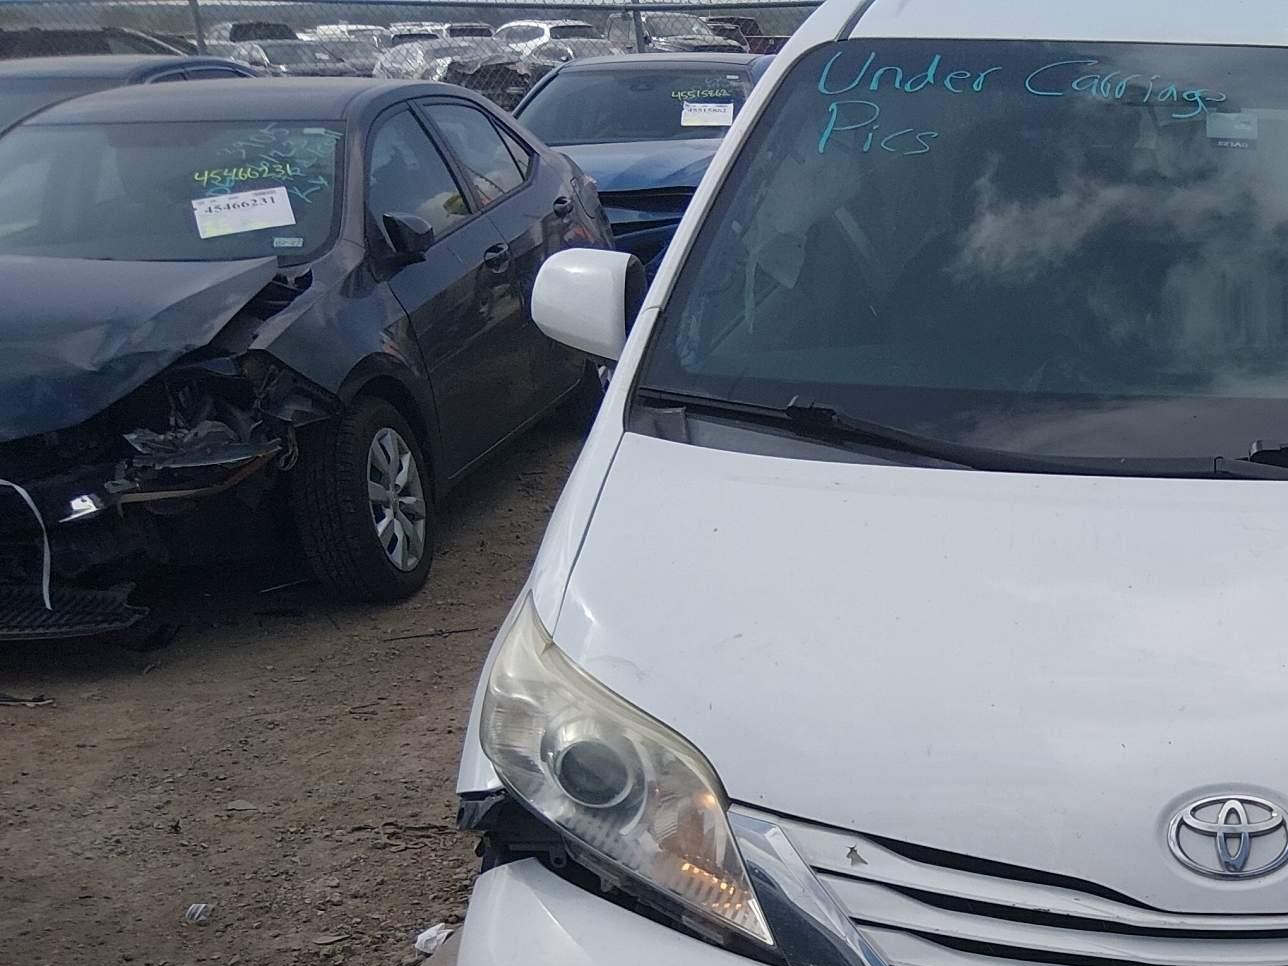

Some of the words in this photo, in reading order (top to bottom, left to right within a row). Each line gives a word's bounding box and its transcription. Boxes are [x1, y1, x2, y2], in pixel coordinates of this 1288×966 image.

[817, 51, 1003, 94] Under
[817, 100, 939, 155] Pics
[204, 196, 276, 214] 45466231
